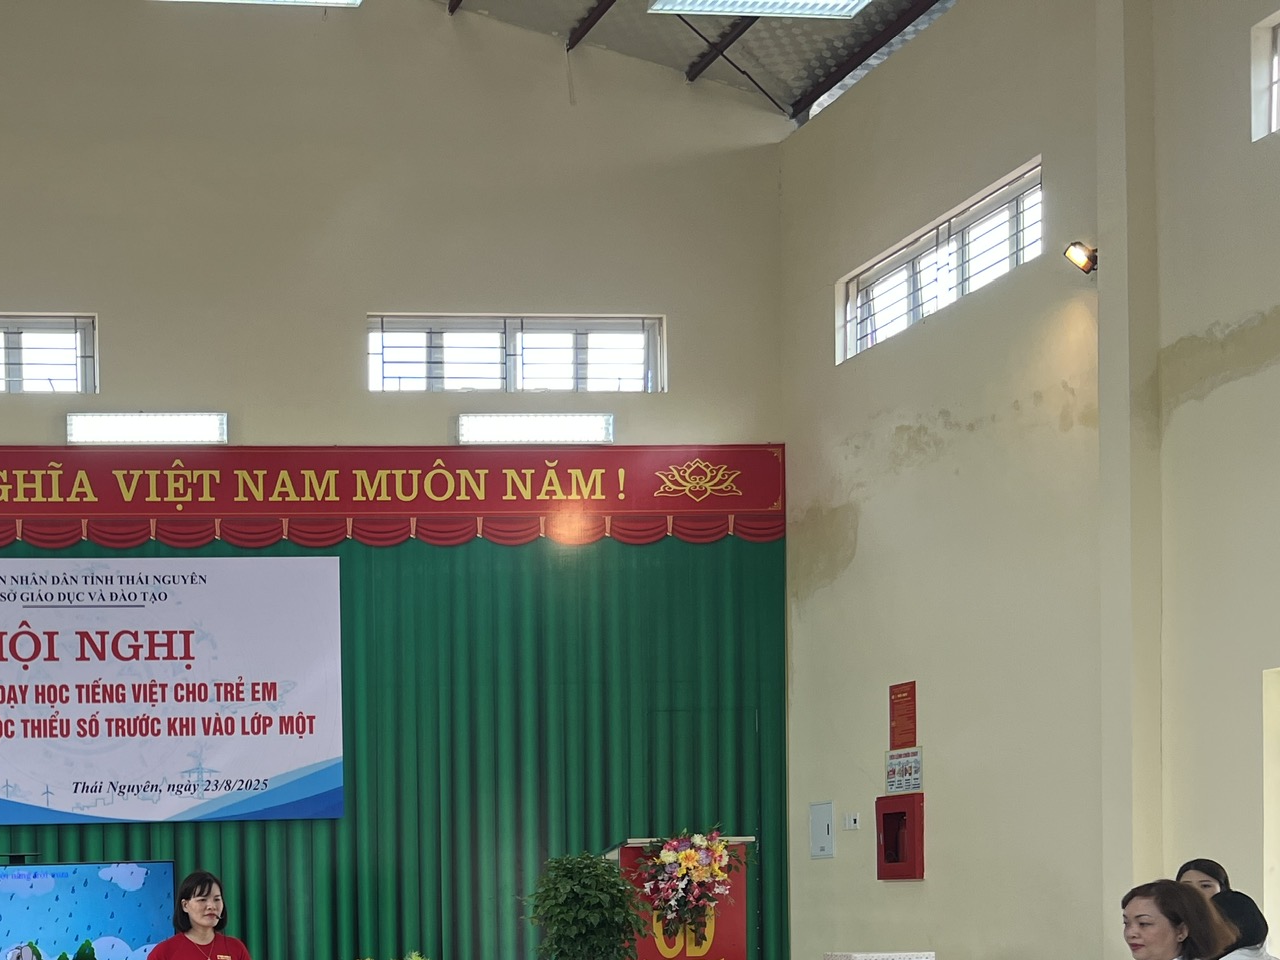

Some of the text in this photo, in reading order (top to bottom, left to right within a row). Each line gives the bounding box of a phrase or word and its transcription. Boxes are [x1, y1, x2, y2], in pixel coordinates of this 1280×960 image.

[115, 461, 219, 509] VIỆT
[236, 471, 338, 501] NAM
[355, 460, 486, 501] MUÔN
[505, 464, 604, 500] NĂM
[10, 573, 48, 586] NHÂN
[51, 572, 79, 586] DÂN
[81, 572, 114, 586] TỈNH
[116, 572, 149, 586] THÁI
[152, 571, 207, 586] NGUYÊN
[0, 589, 168, 604] SỞ GIÁO DỤC VÀ ĐÀO TẠO
[77, 630, 195, 671] NGHỊ
[35, 685, 70, 706] HỌC
[76, 678, 127, 704] TIẾNG
[132, 681, 168, 706] VIỆT
[173, 683, 209, 703] CHO
[215, 677, 245, 702] TRẺ
[251, 682, 278, 702] EM
[22, 711, 71, 738] THIỂU
[77, 712, 100, 738] SỐ
[106, 713, 162, 738] TRƯỚC
[167, 717, 196, 736] KHI
[202, 713, 236, 736] VÀO
[241, 715, 274, 736] LỚP
[279, 713, 316, 739] MỘT
[72, 778, 269, 798] Thái Nguyên, ngày 23/8/2025
